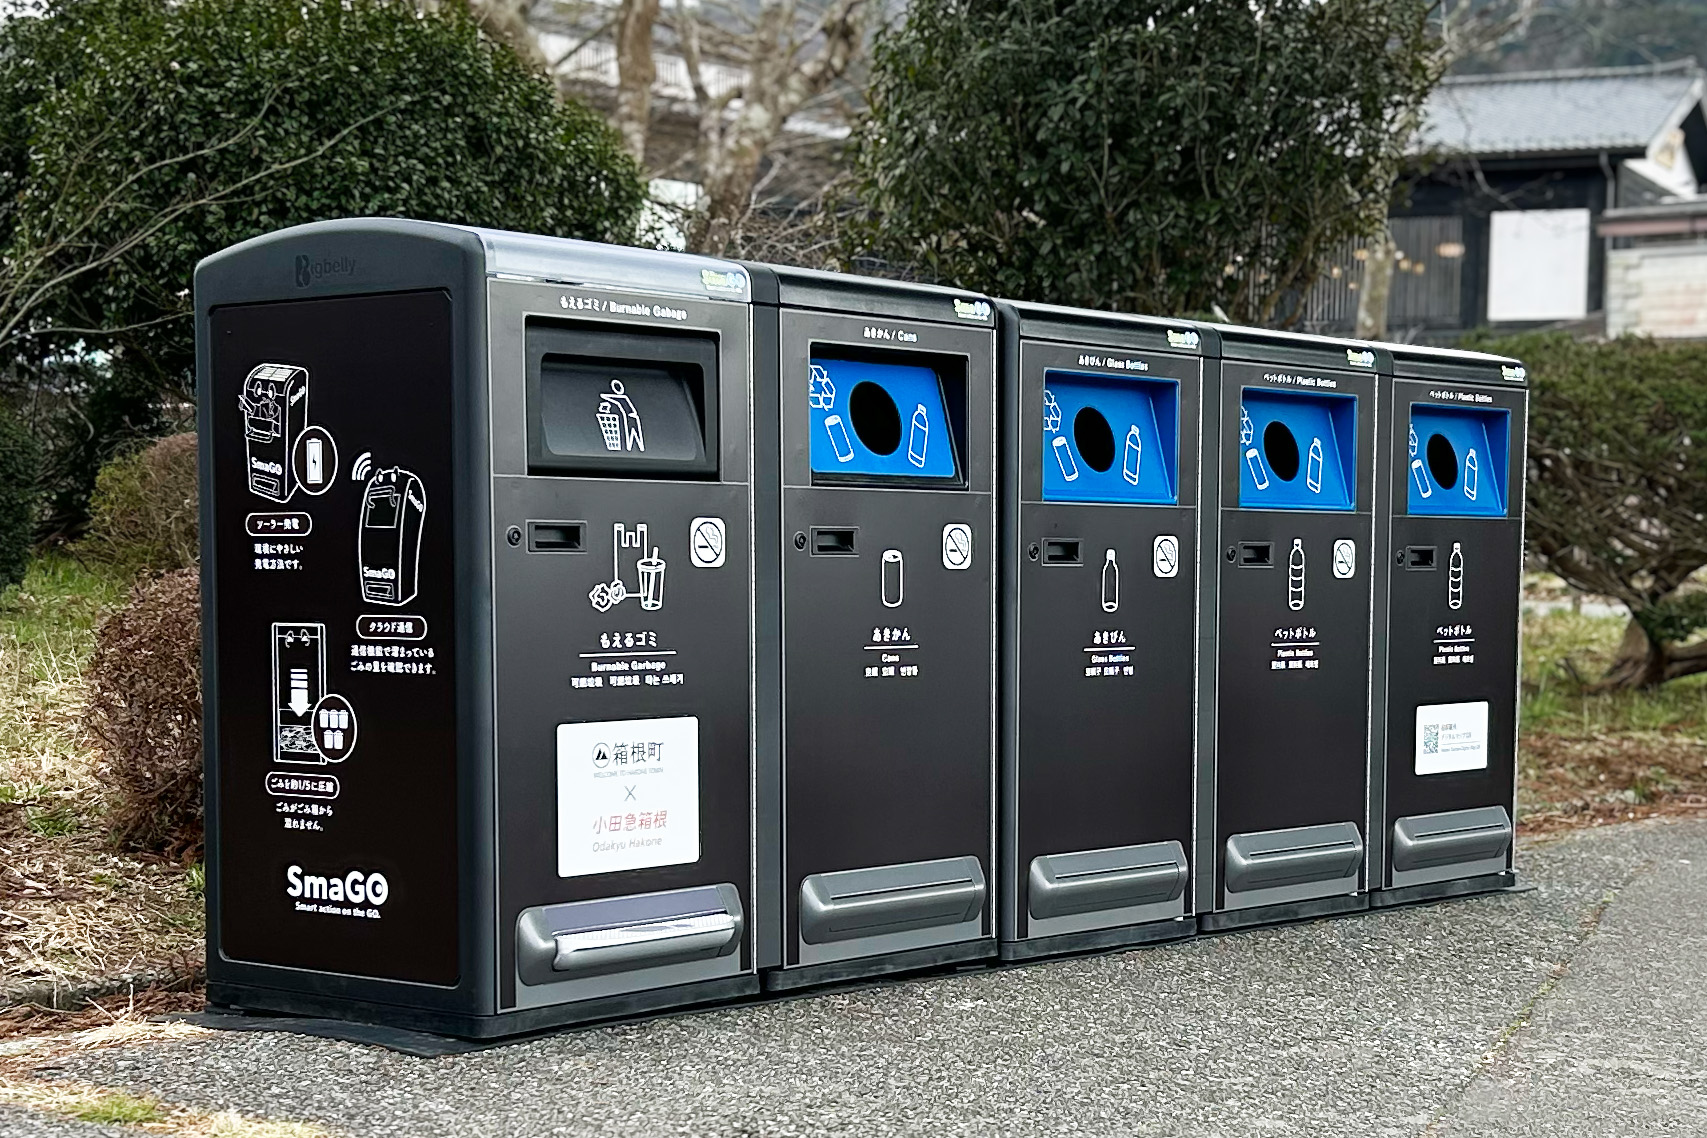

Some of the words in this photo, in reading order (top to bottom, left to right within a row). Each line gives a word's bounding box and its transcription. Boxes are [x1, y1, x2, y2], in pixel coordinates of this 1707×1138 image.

[560, 296, 599, 311] もえるゴミ
[610, 301, 650, 316] Burnable
[600, 631, 657, 649] もえるゴミ
[872, 627, 911, 642] あきかん
[1274, 626, 1317, 640] ペットボトル
[612, 741, 665, 766] 箱根町
[592, 810, 668, 835] 小田急箱根
[592, 839, 627, 853] Odakyu
[629, 837, 663, 849] Hakone
[286, 865, 388, 906] SmaGO
[295, 901, 318, 912] Smart
[319, 904, 341, 915] action
[342, 907, 352, 916] on
[353, 907, 366, 917] the
